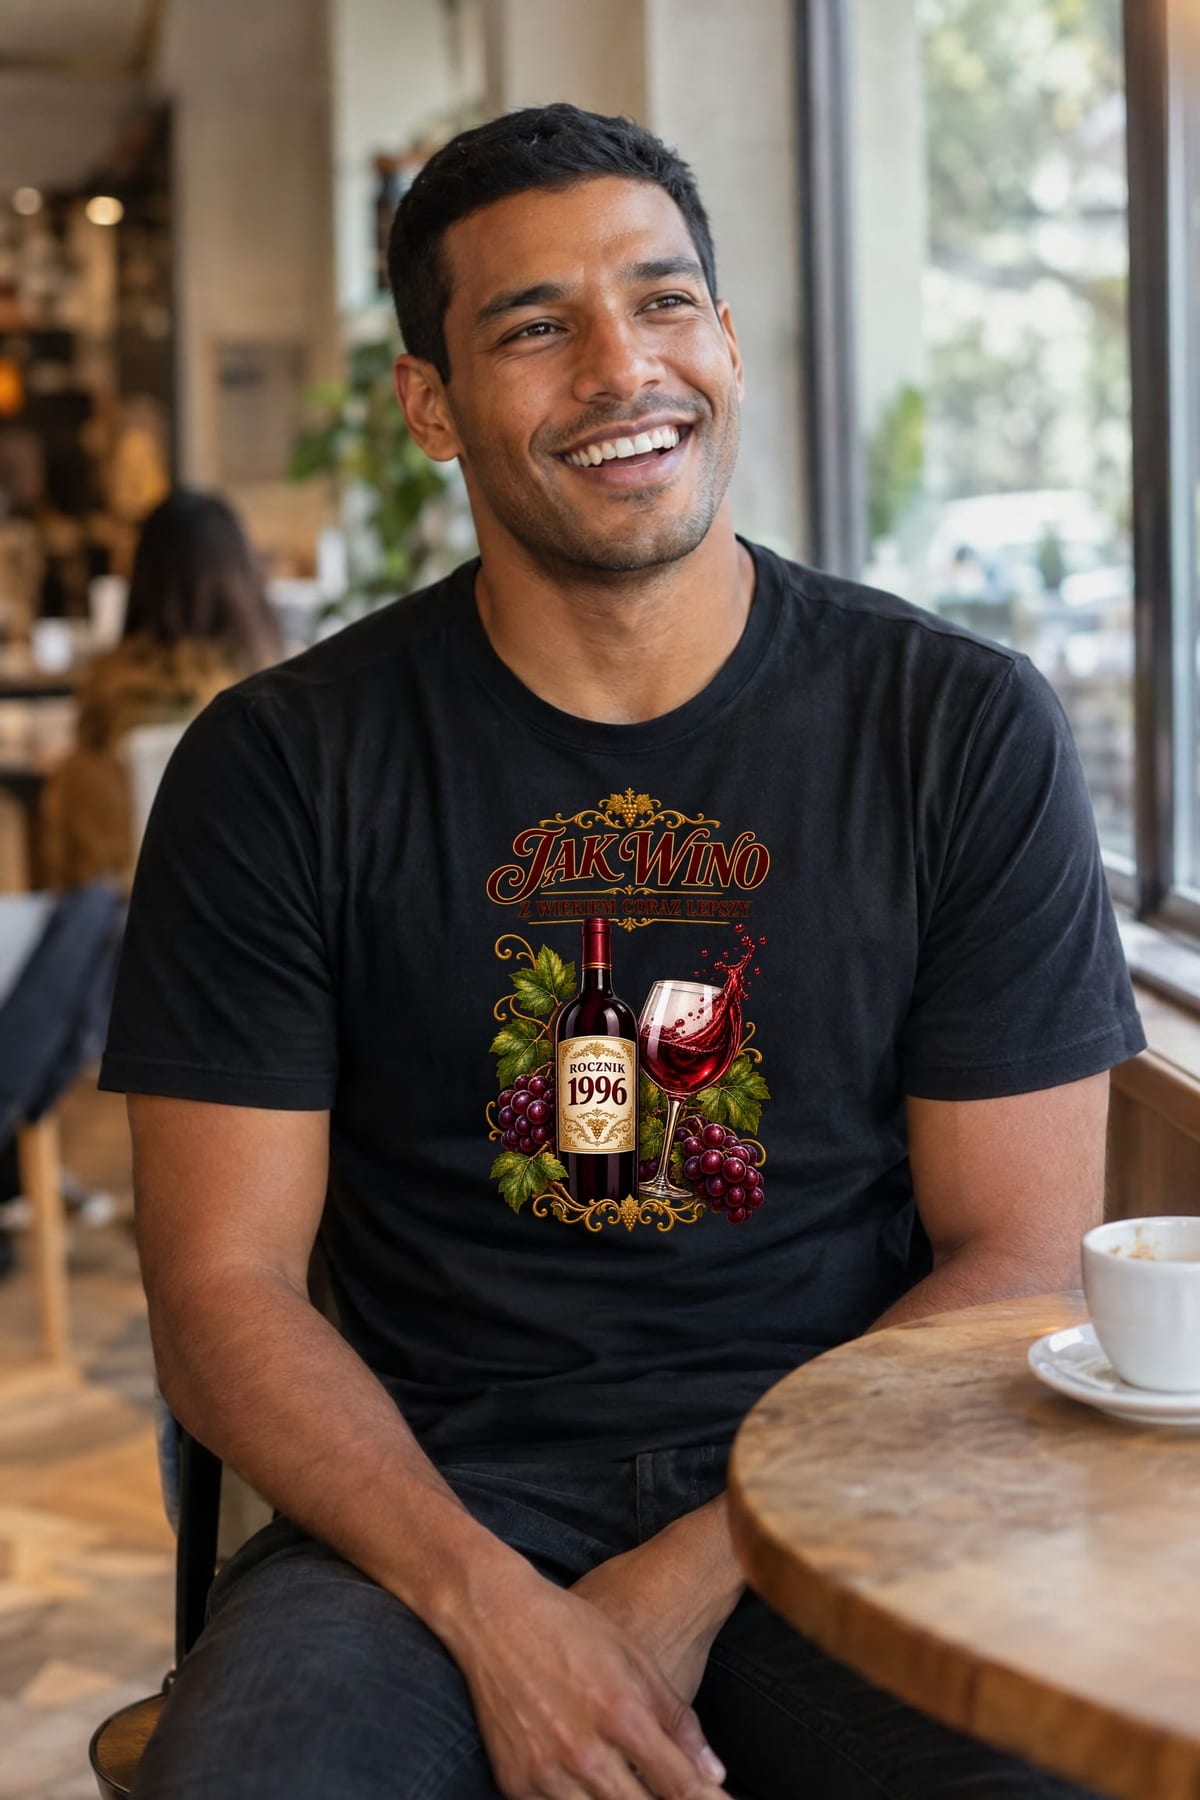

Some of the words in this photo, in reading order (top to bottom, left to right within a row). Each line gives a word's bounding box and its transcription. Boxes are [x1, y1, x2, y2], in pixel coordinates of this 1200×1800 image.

[486, 827, 624, 905] JAK
[618, 827, 770, 890] WINO
[519, 902, 531, 918] Z
[536, 900, 616, 917] WIEKIEM
[622, 899, 681, 916] CORAZ
[687, 900, 752, 917] LEPSZY
[570, 1062, 625, 1074] ROCZNIK
[568, 1076, 627, 1106] 1996
